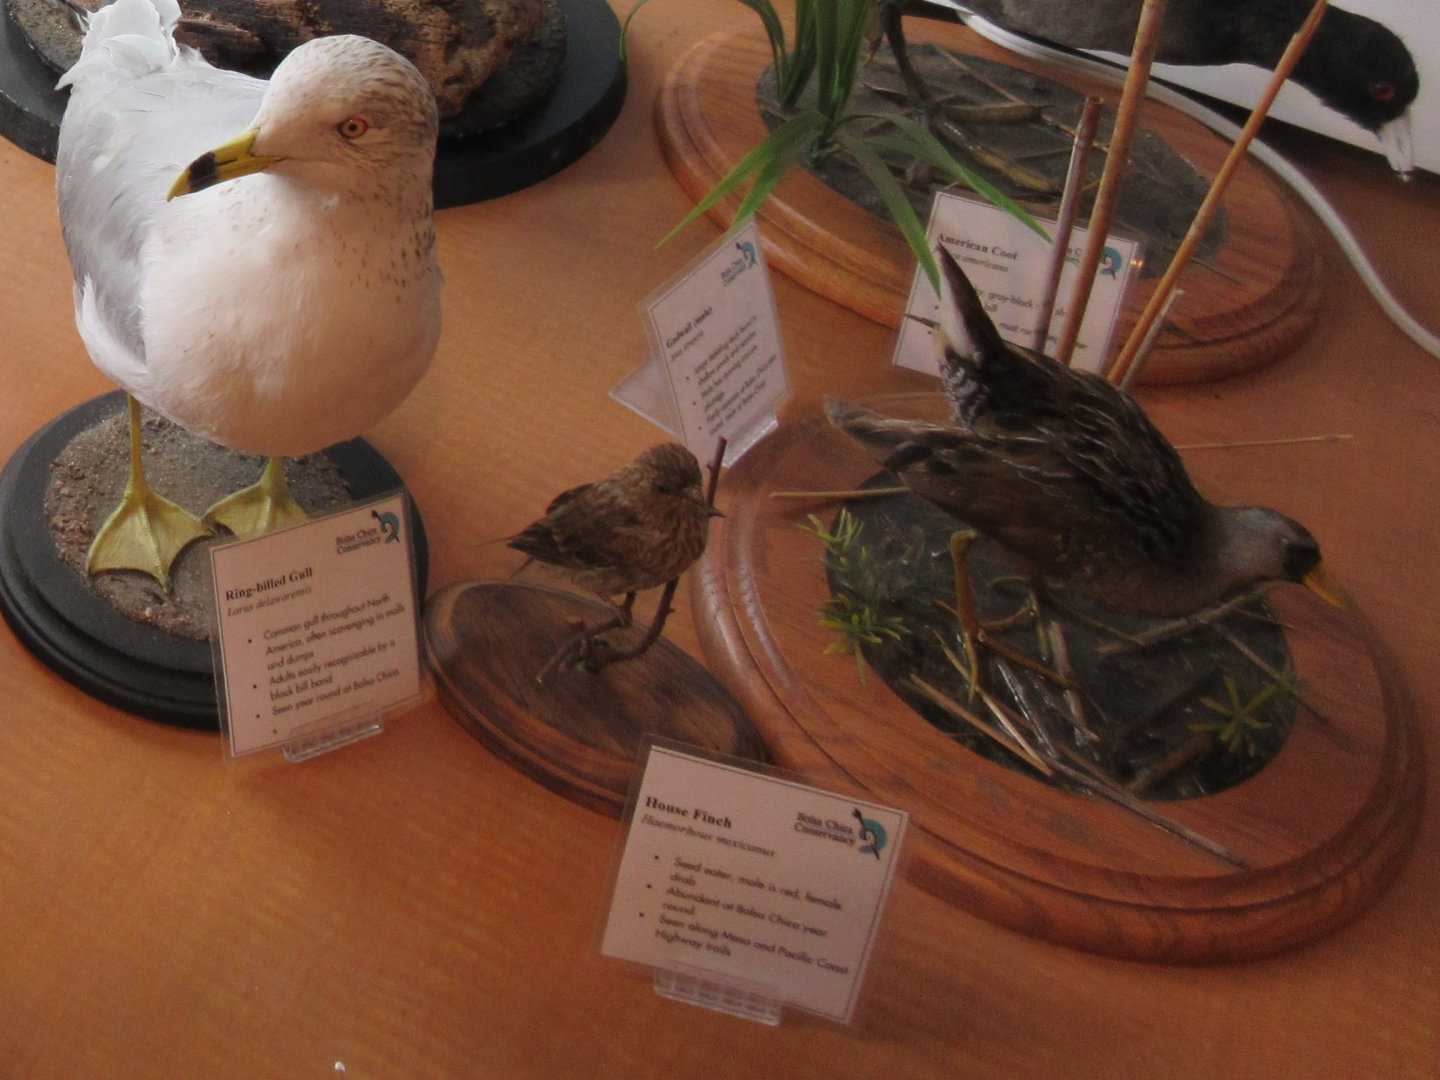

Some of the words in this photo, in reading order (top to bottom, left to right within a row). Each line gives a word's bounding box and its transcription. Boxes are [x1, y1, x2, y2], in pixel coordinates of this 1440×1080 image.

[992, 246, 1019, 260] Coot
[226, 575, 286, 601] Ring-billed
[289, 567, 312, 582] Gull
[646, 796, 688, 816] House
[693, 809, 731, 828] Finch
